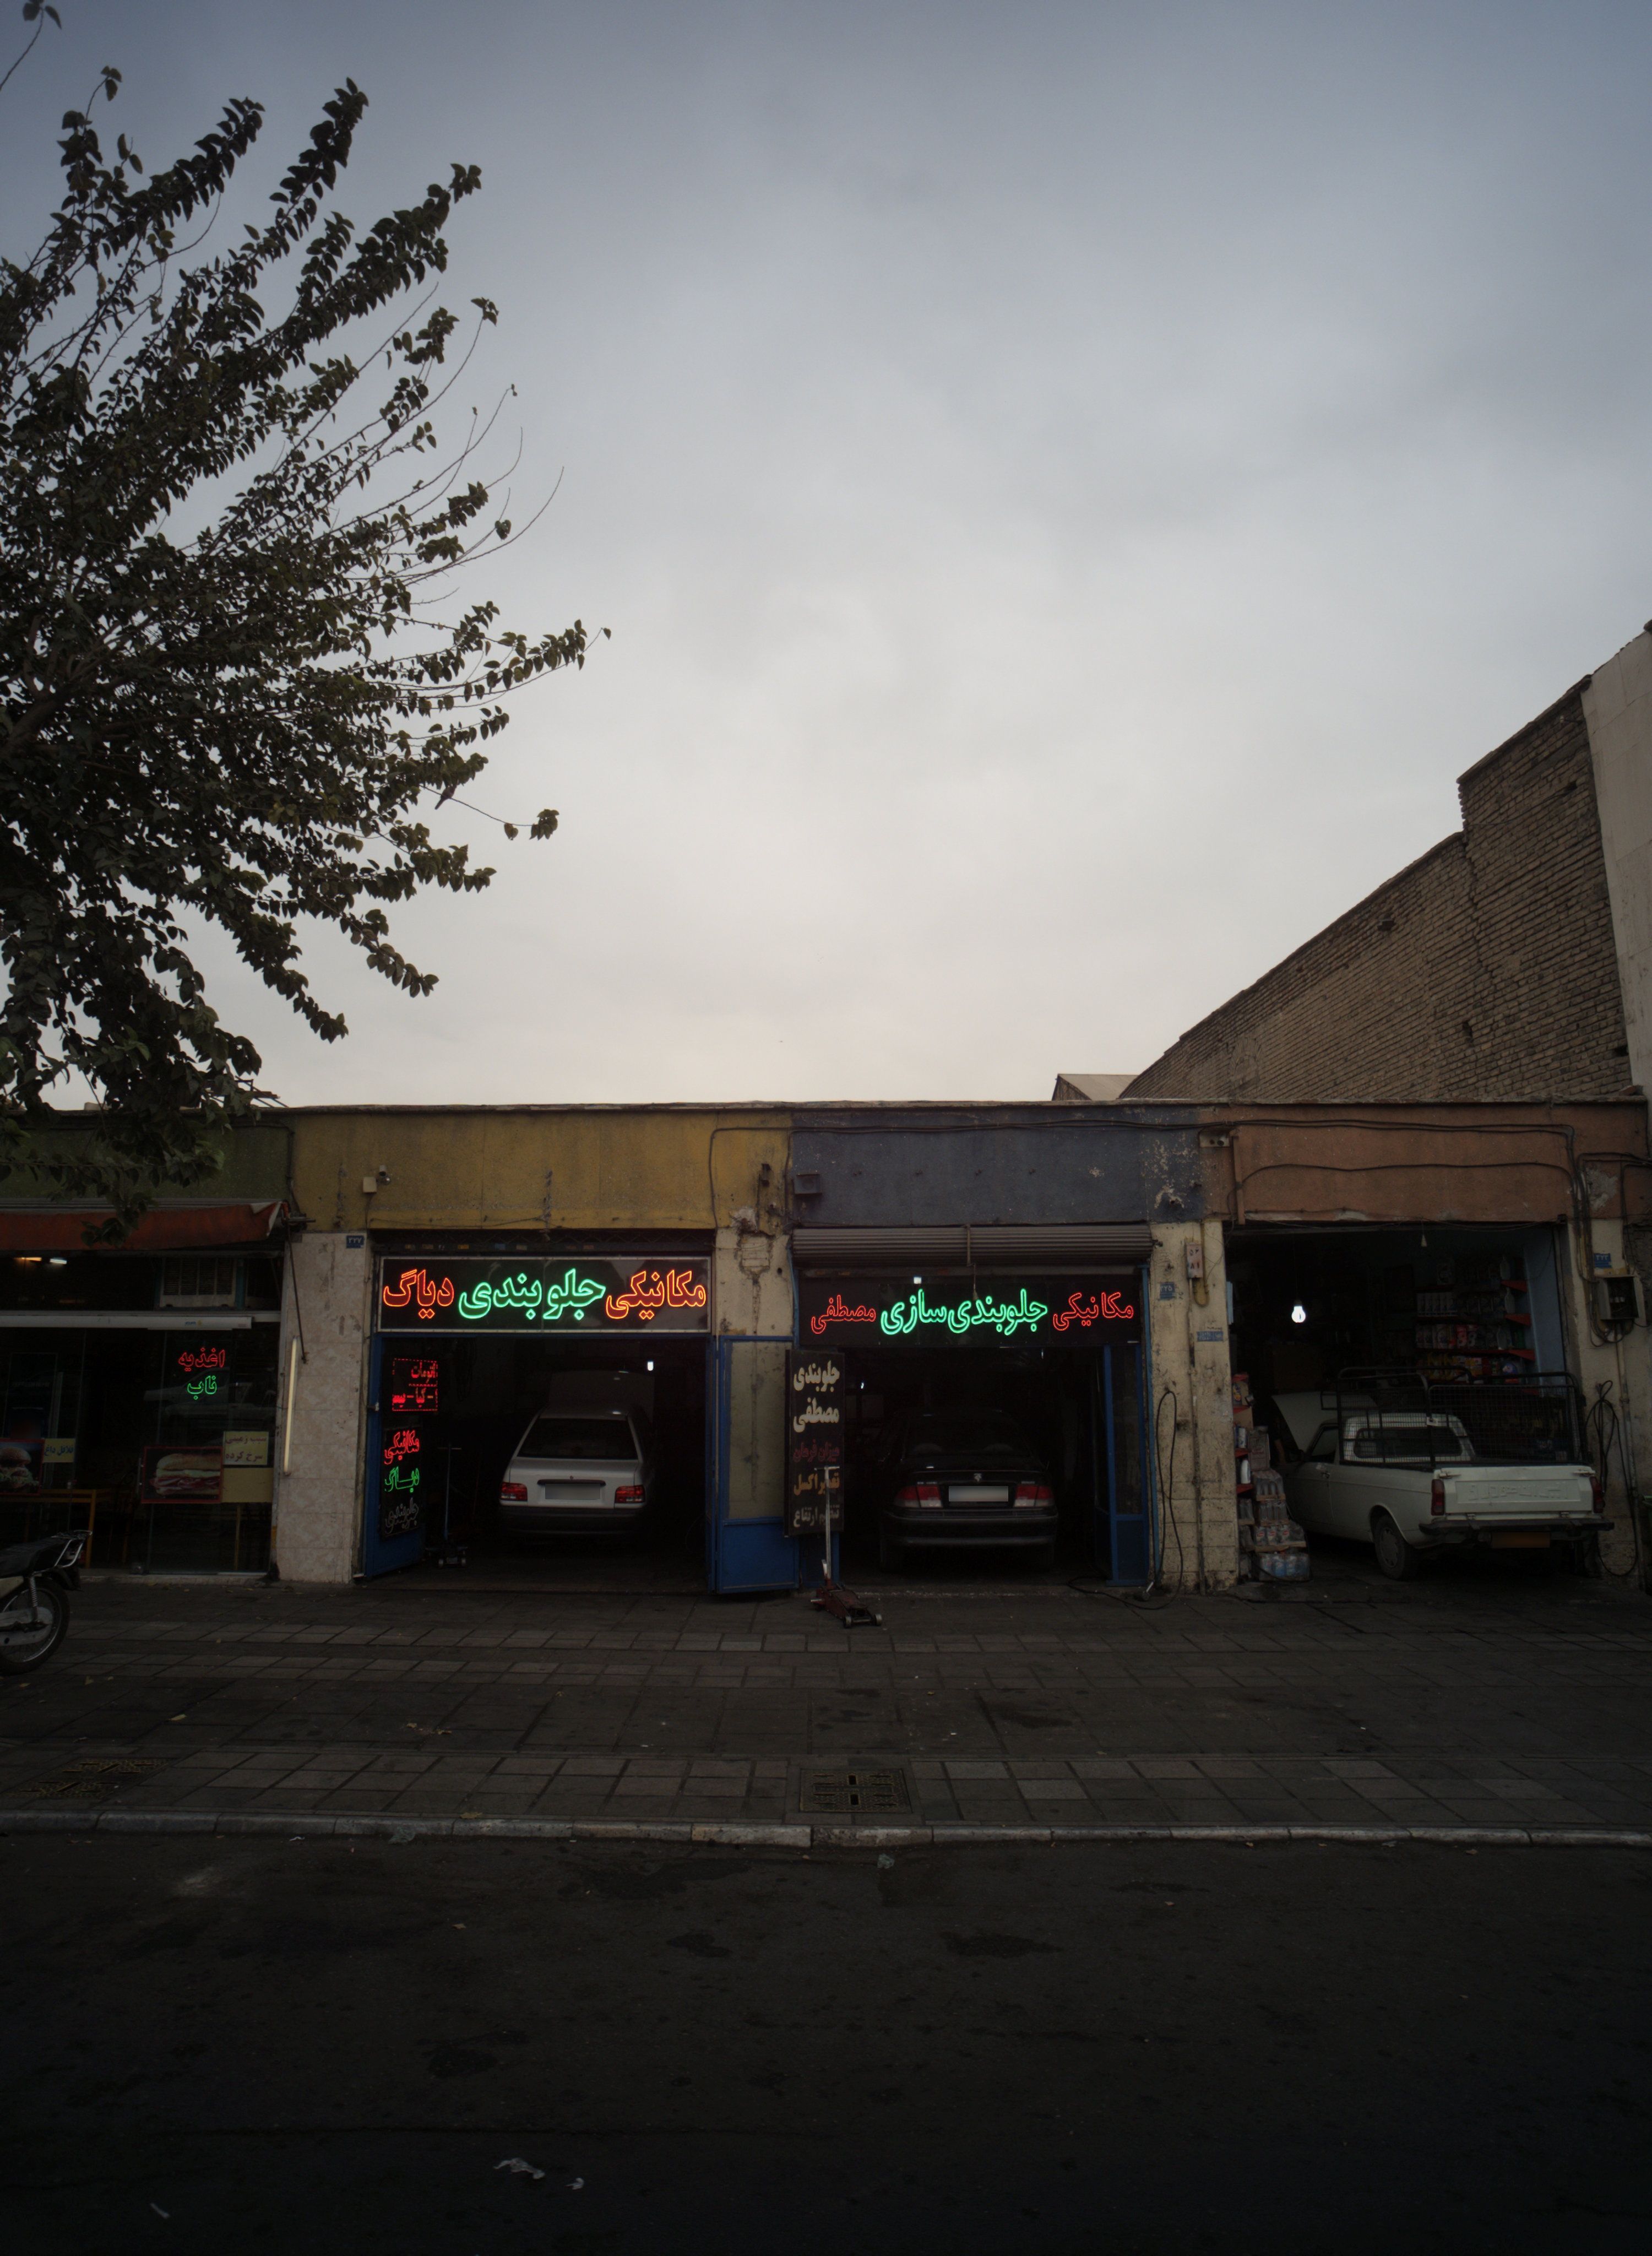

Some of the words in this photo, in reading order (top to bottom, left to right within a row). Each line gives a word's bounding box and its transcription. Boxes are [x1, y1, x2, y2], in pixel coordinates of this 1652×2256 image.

[383, 1268, 455, 1320] دیاگ
[606, 1269, 707, 1320] مکانیکی
[1053, 1292, 1134, 1331] مکانیکی
[811, 1294, 877, 1335] مصطفی
[178, 1347, 226, 1372] اغذیه
[793, 1359, 840, 1393] جلوبندی
[186, 1375, 218, 1401] ناب
[793, 1396, 840, 1433] مصطفی
[383, 1428, 421, 1466] مکانیکی
[793, 1472, 819, 1496] اکسل
[817, 1471, 840, 1495] تعیر
[793, 1506, 818, 1528] ارتفاع
